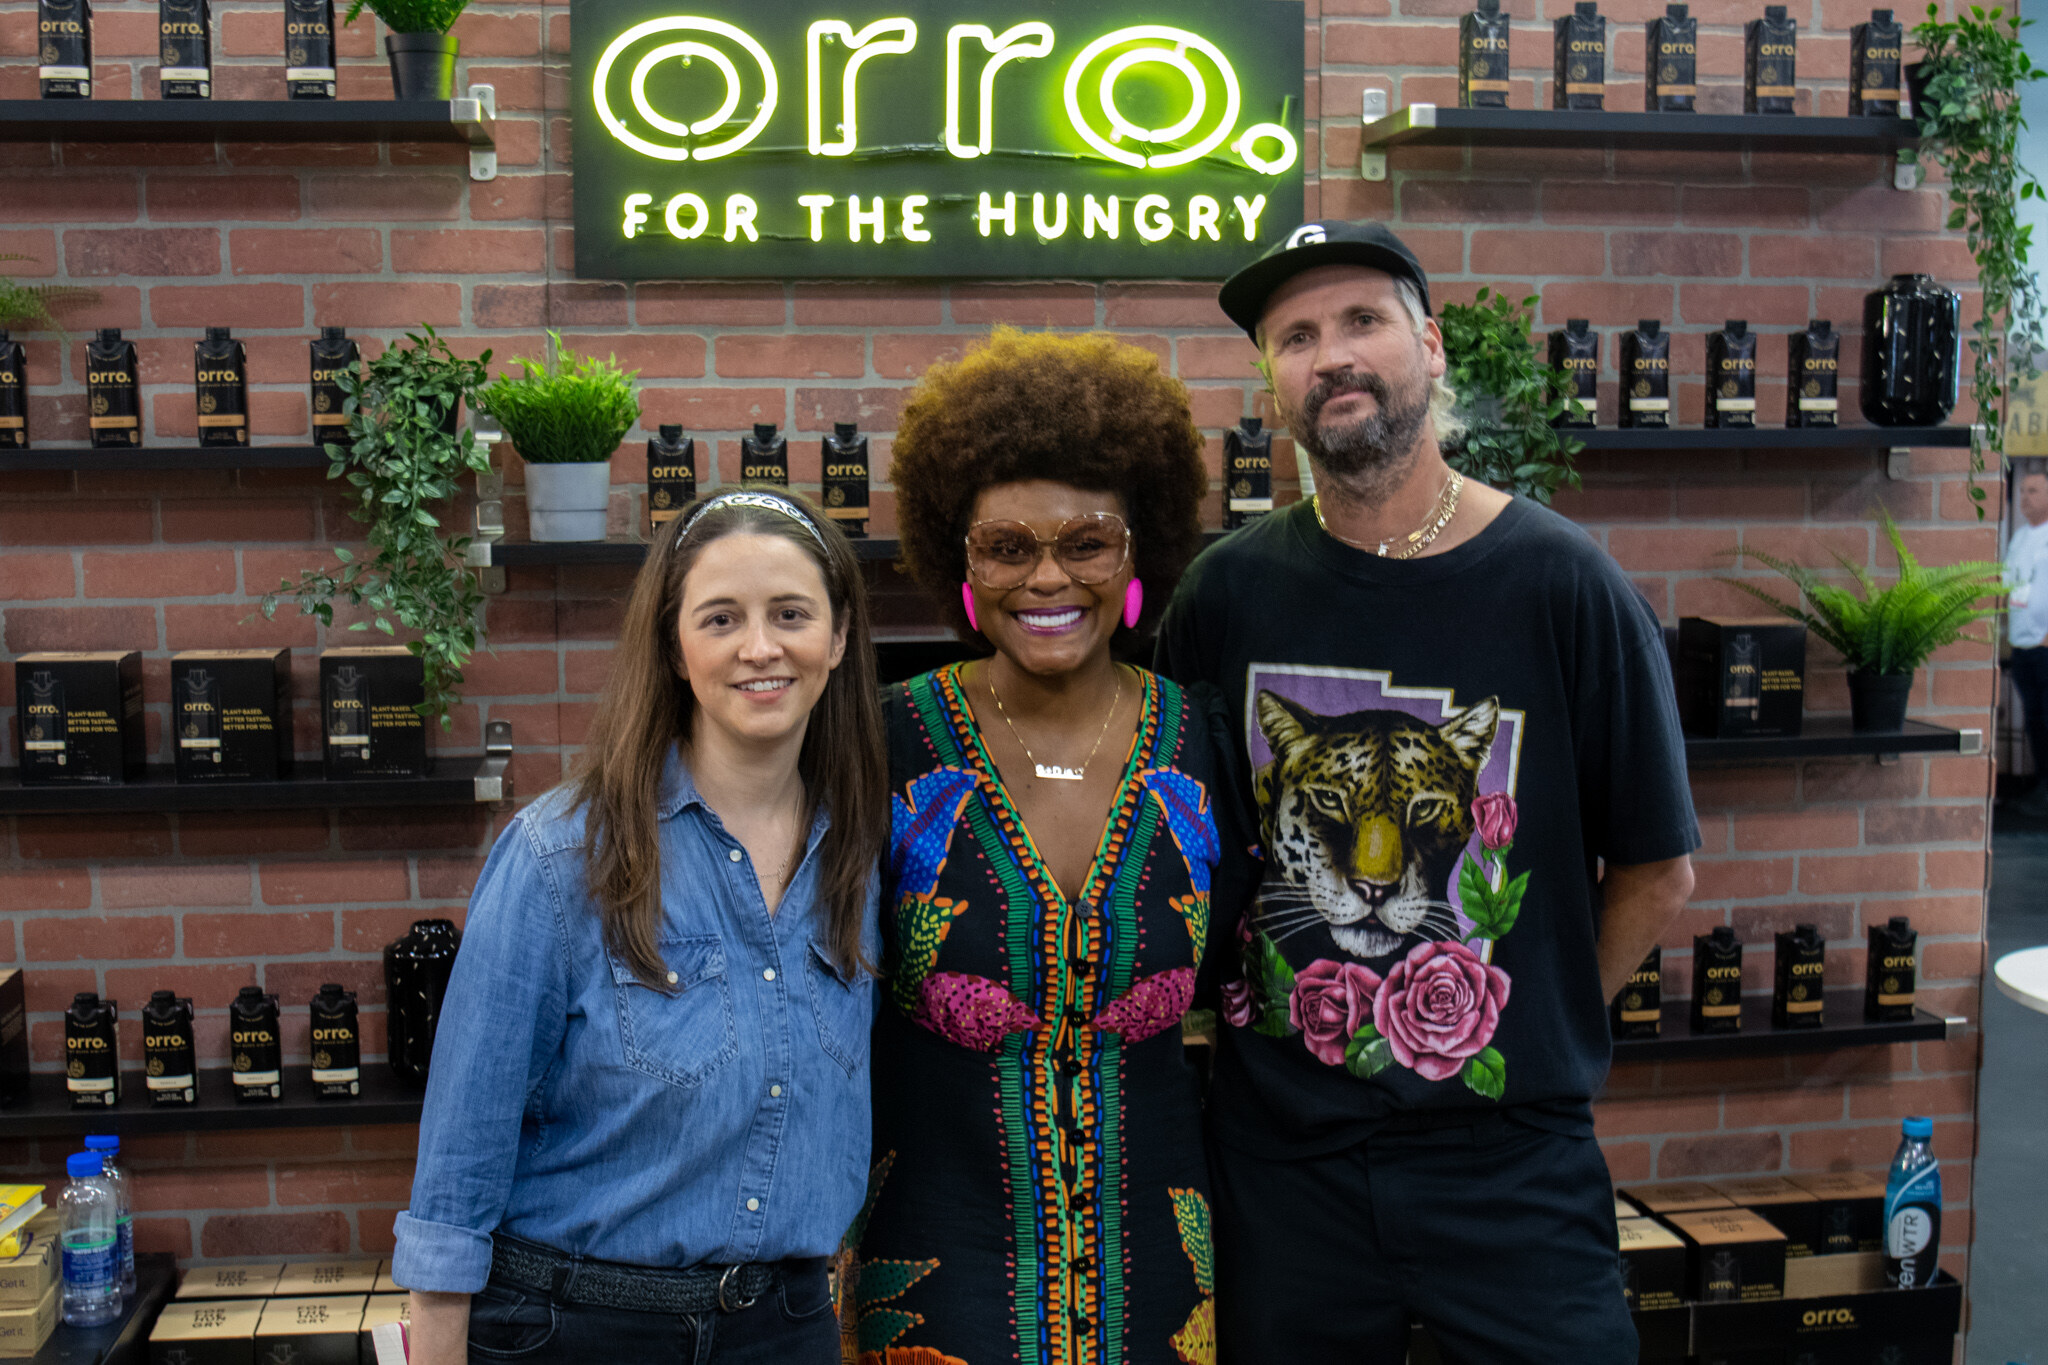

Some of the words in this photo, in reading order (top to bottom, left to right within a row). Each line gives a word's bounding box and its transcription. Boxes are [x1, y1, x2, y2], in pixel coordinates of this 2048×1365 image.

[41, 21, 83, 33] orro.
[162, 22, 204, 35] orro.
[288, 22, 330, 35] orro.
[623, 193, 759, 243] FOR
[798, 194, 931, 243] THE
[978, 191, 1267, 244] HUNGRY
[89, 371, 131, 383] orro.
[198, 370, 239, 382] orro.
[652, 465, 692, 478] orro.
[745, 465, 785, 477] orro.
[827, 464, 867, 476] orro.
[28, 704, 59, 714] orro.
[184, 702, 215, 712] orro.
[332, 699, 363, 709] orro.
[146, 1034, 186, 1047] orro.
[233, 1030, 273, 1043] orro.
[313, 1028, 353, 1041] orro.
[67, 1037, 107, 1049] orro.
[1802, 1308, 1855, 1326] orro.
